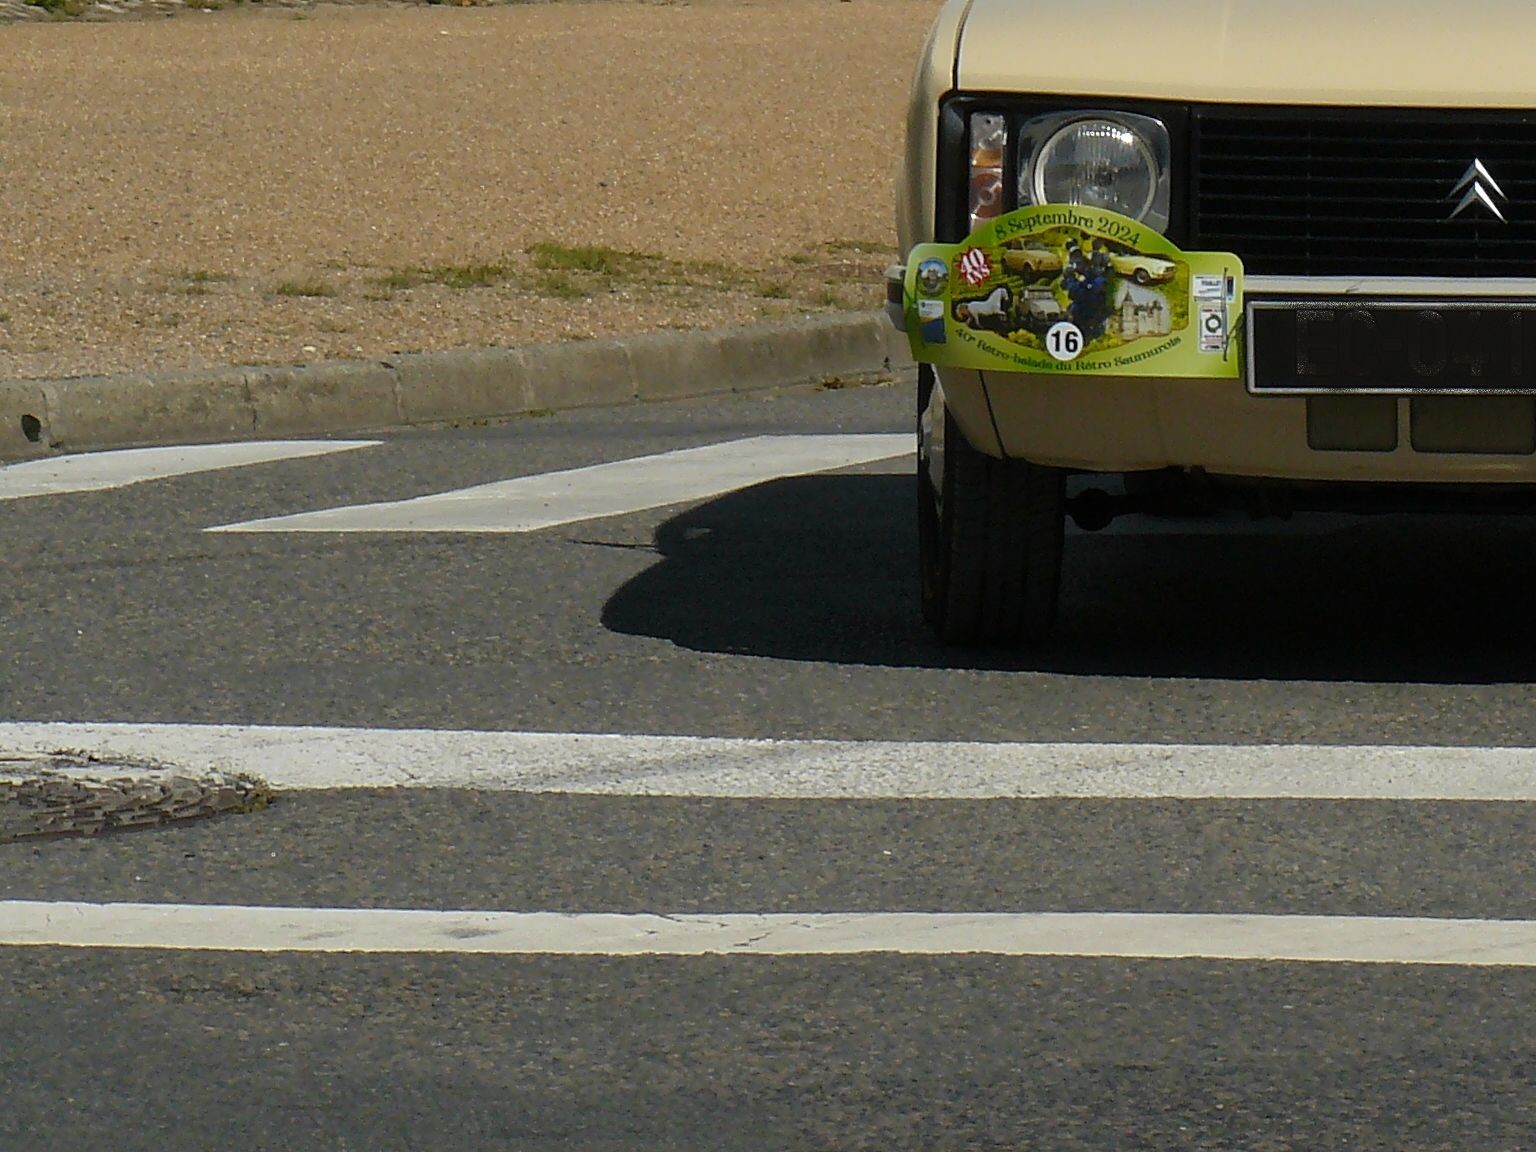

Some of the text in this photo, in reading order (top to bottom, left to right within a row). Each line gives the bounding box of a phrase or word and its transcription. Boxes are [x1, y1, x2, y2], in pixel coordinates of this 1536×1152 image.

[995, 210, 1140, 245] 8 Septembre 2024
[962, 249, 985, 273] 40
[1051, 331, 1078, 353] 16
[1056, 359, 1073, 371] du
[1114, 335, 1182, 366] Saumurois
